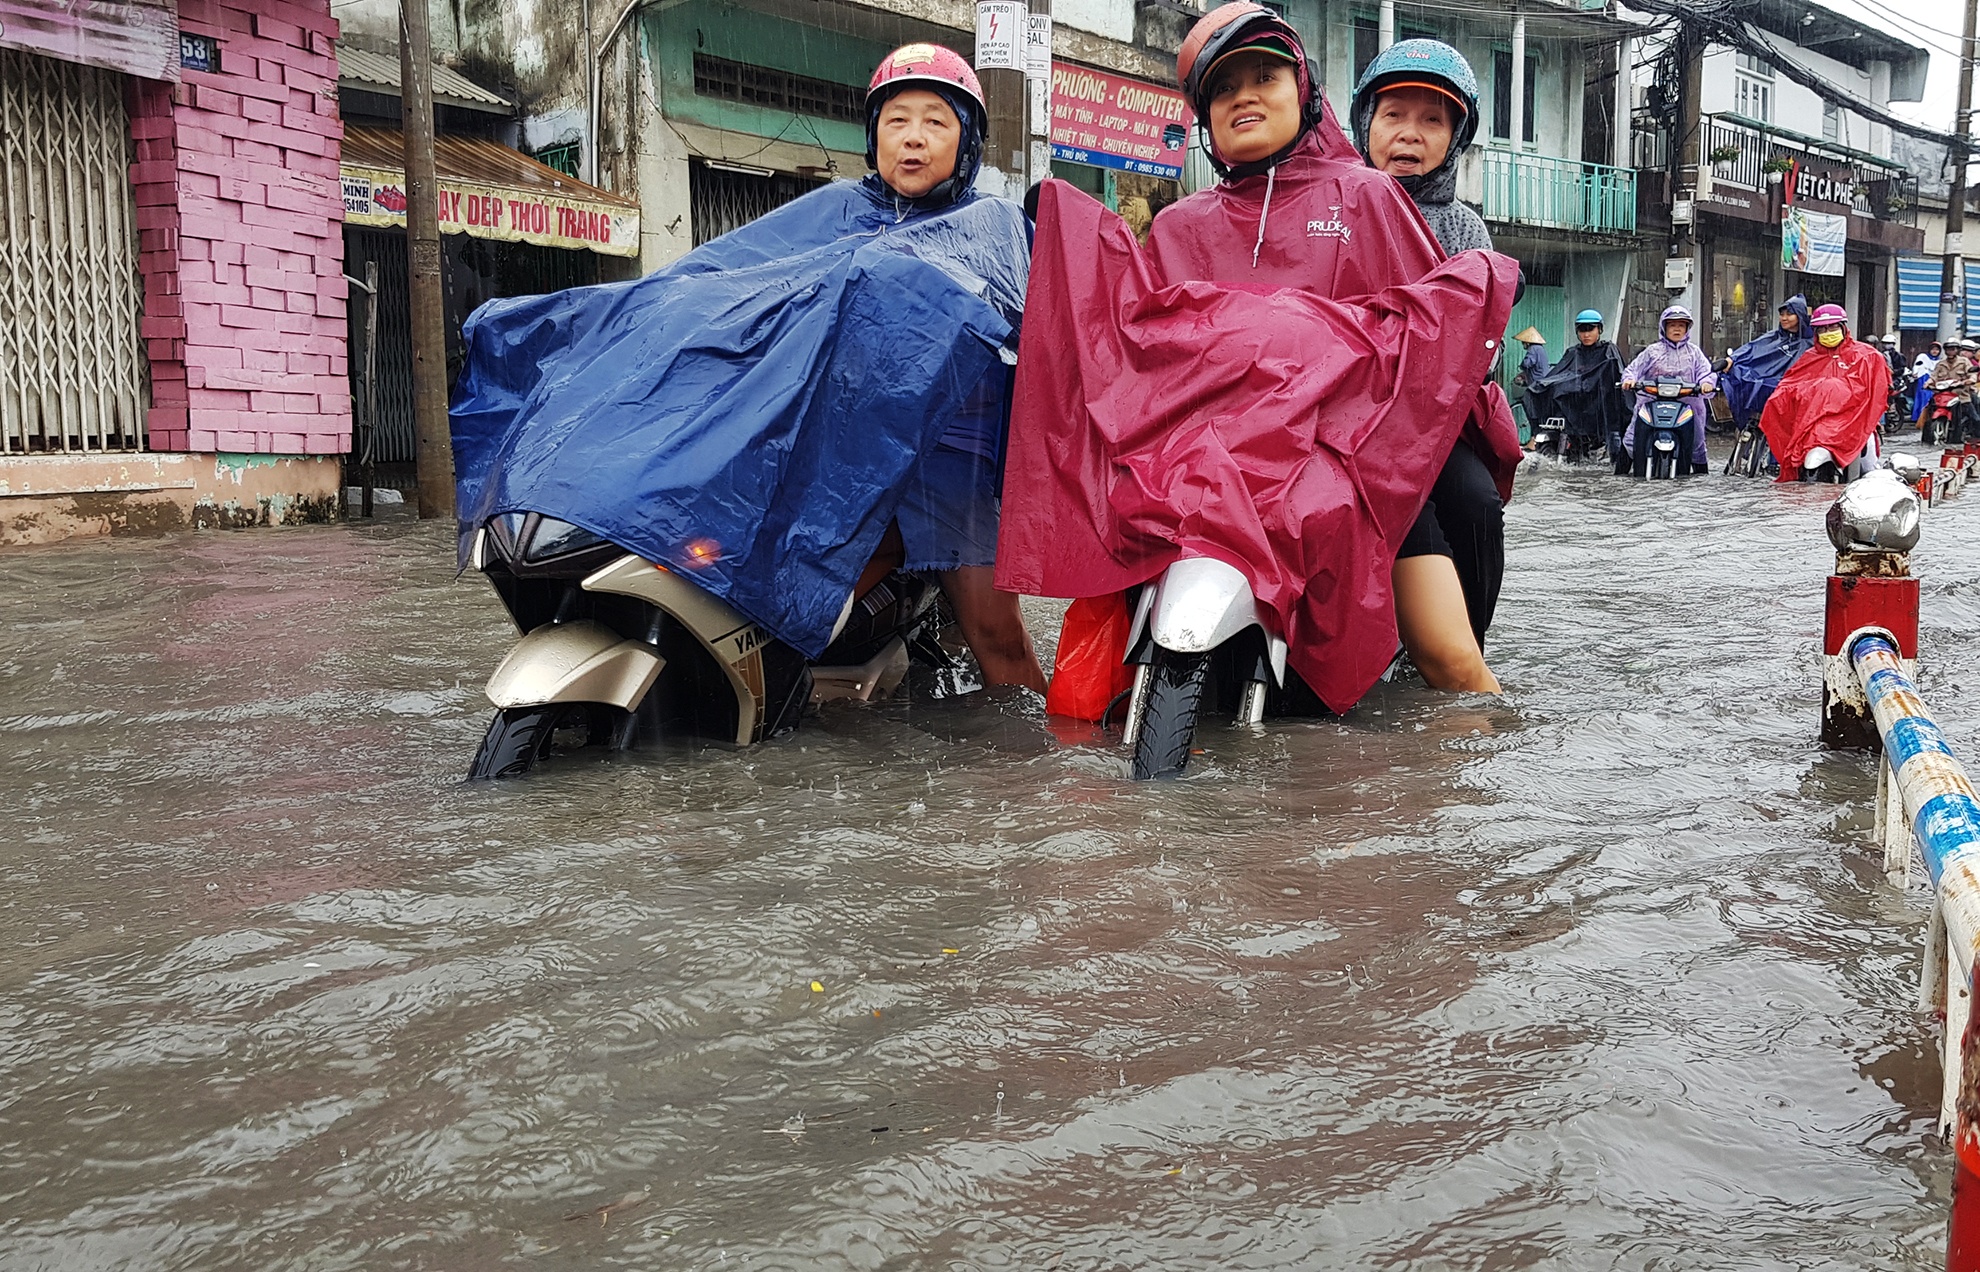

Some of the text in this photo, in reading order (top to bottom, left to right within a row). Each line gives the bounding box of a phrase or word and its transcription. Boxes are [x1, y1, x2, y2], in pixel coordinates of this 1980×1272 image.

[1028, 17, 1047, 29] ONV
[1051, 70, 1107, 105] PHƯƠNG
[1117, 86, 1185, 121] COMPUTER
[1054, 103, 1075, 121] MÁY
[1075, 107, 1094, 125] TÍNH
[1099, 114, 1128, 132] LAPTOP
[1133, 119, 1150, 138] MÁY
[1150, 125, 1160, 139] IN
[1052, 127, 1078, 146] NHIỆT
[1079, 130, 1098, 148] TÌNH
[1102, 137, 1132, 155] CHUYÊN
[1133, 144, 1161, 161] NGHIỆP
[1062, 148, 1075, 160] THỦ
[1138, 162, 1152, 173] 0985
[1153, 165, 1165, 176] 530
[1166, 167, 1178, 178] 400
[343, 184, 369, 198] MINH
[1817, 171, 1832, 202] CÀ
[1834, 177, 1854, 206] PHÊ
[508, 197, 551, 235] THỜI
[556, 206, 612, 245] TRANG
[1306, 220, 1352, 242] PRUDEAL
